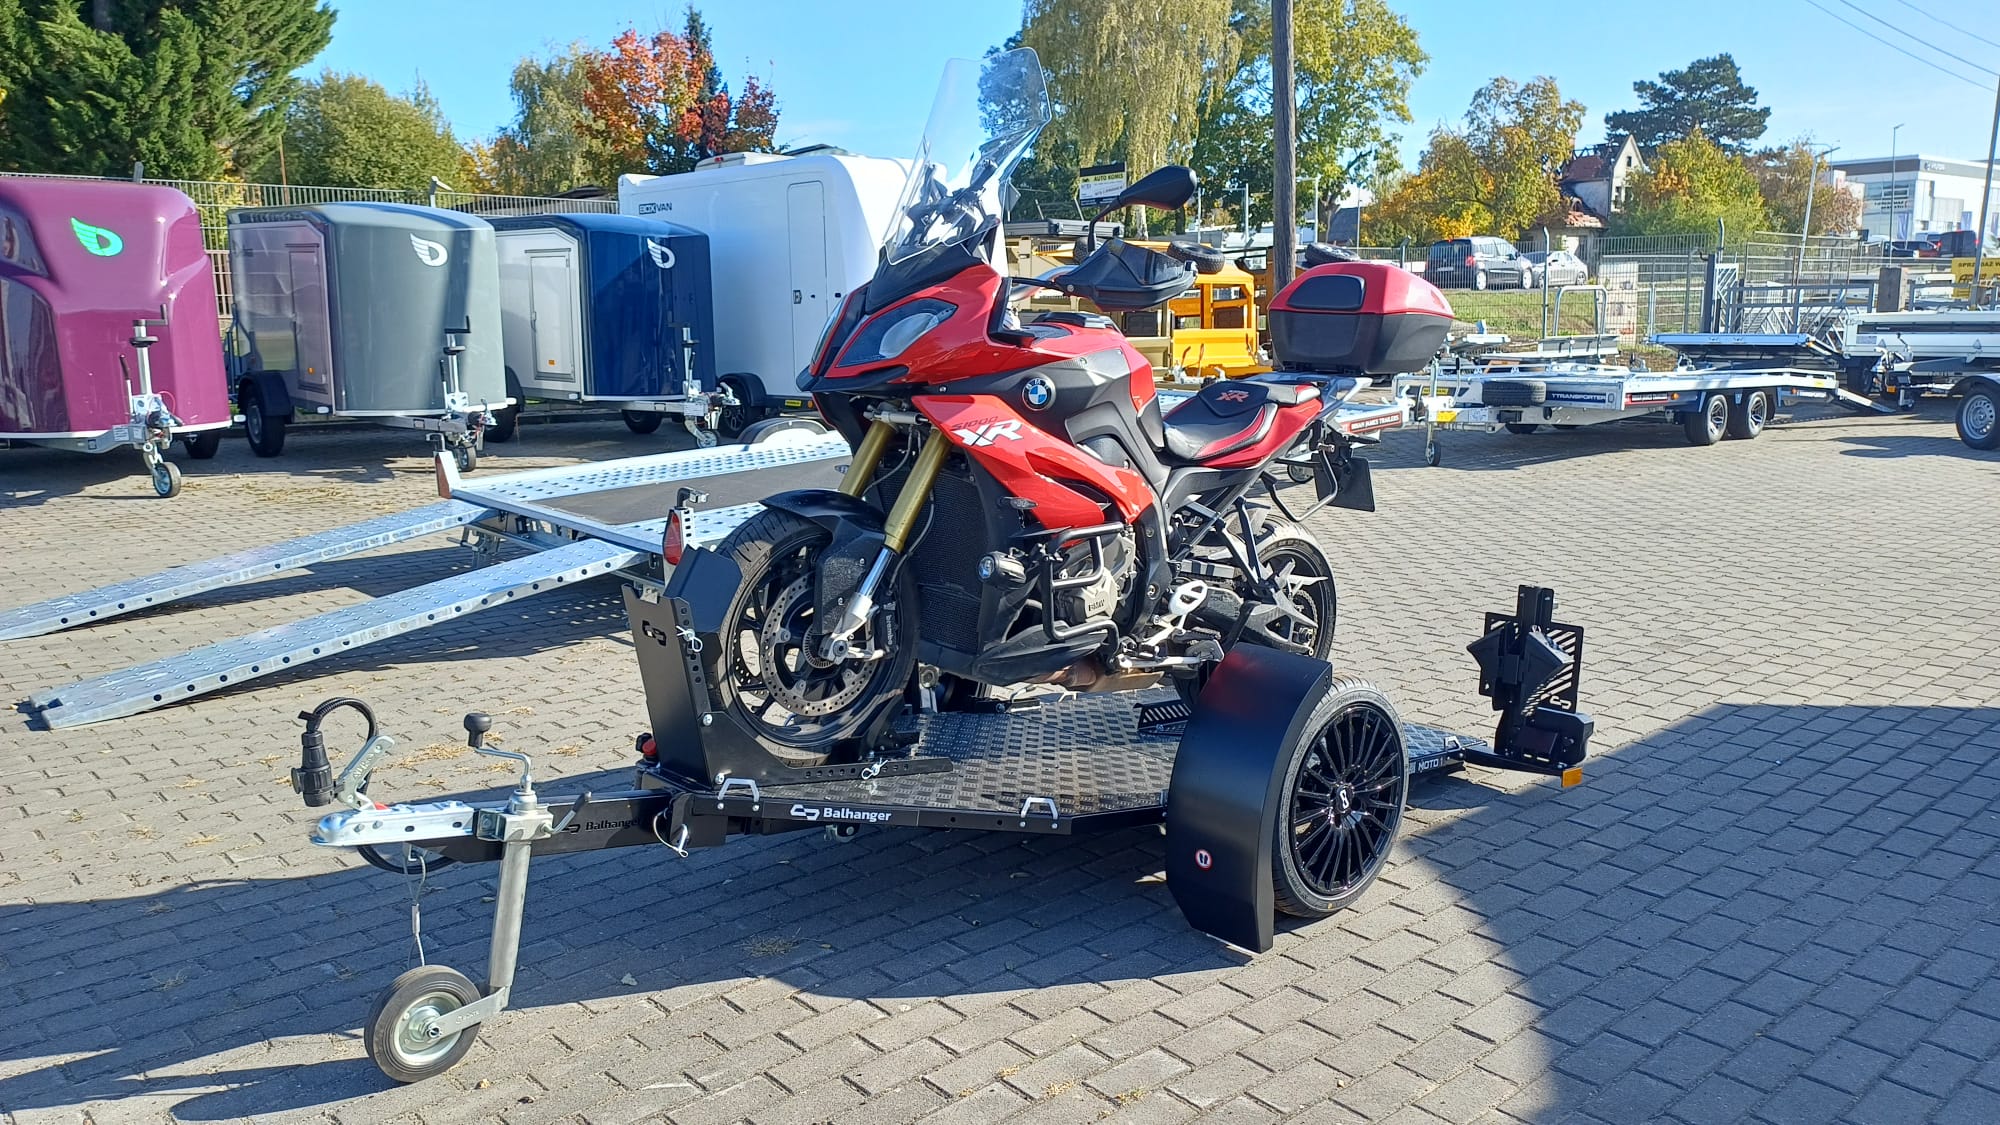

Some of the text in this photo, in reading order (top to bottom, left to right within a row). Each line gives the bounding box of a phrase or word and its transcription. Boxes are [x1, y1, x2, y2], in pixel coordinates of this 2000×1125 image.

[1216, 390, 1249, 403] XR
[952, 416, 999, 430] S1000
[951, 419, 1024, 447] XR
[885, 614, 894, 646] brembo
[1418, 758, 1439, 773] MOTO
[823, 807, 892, 823] Balhanger
